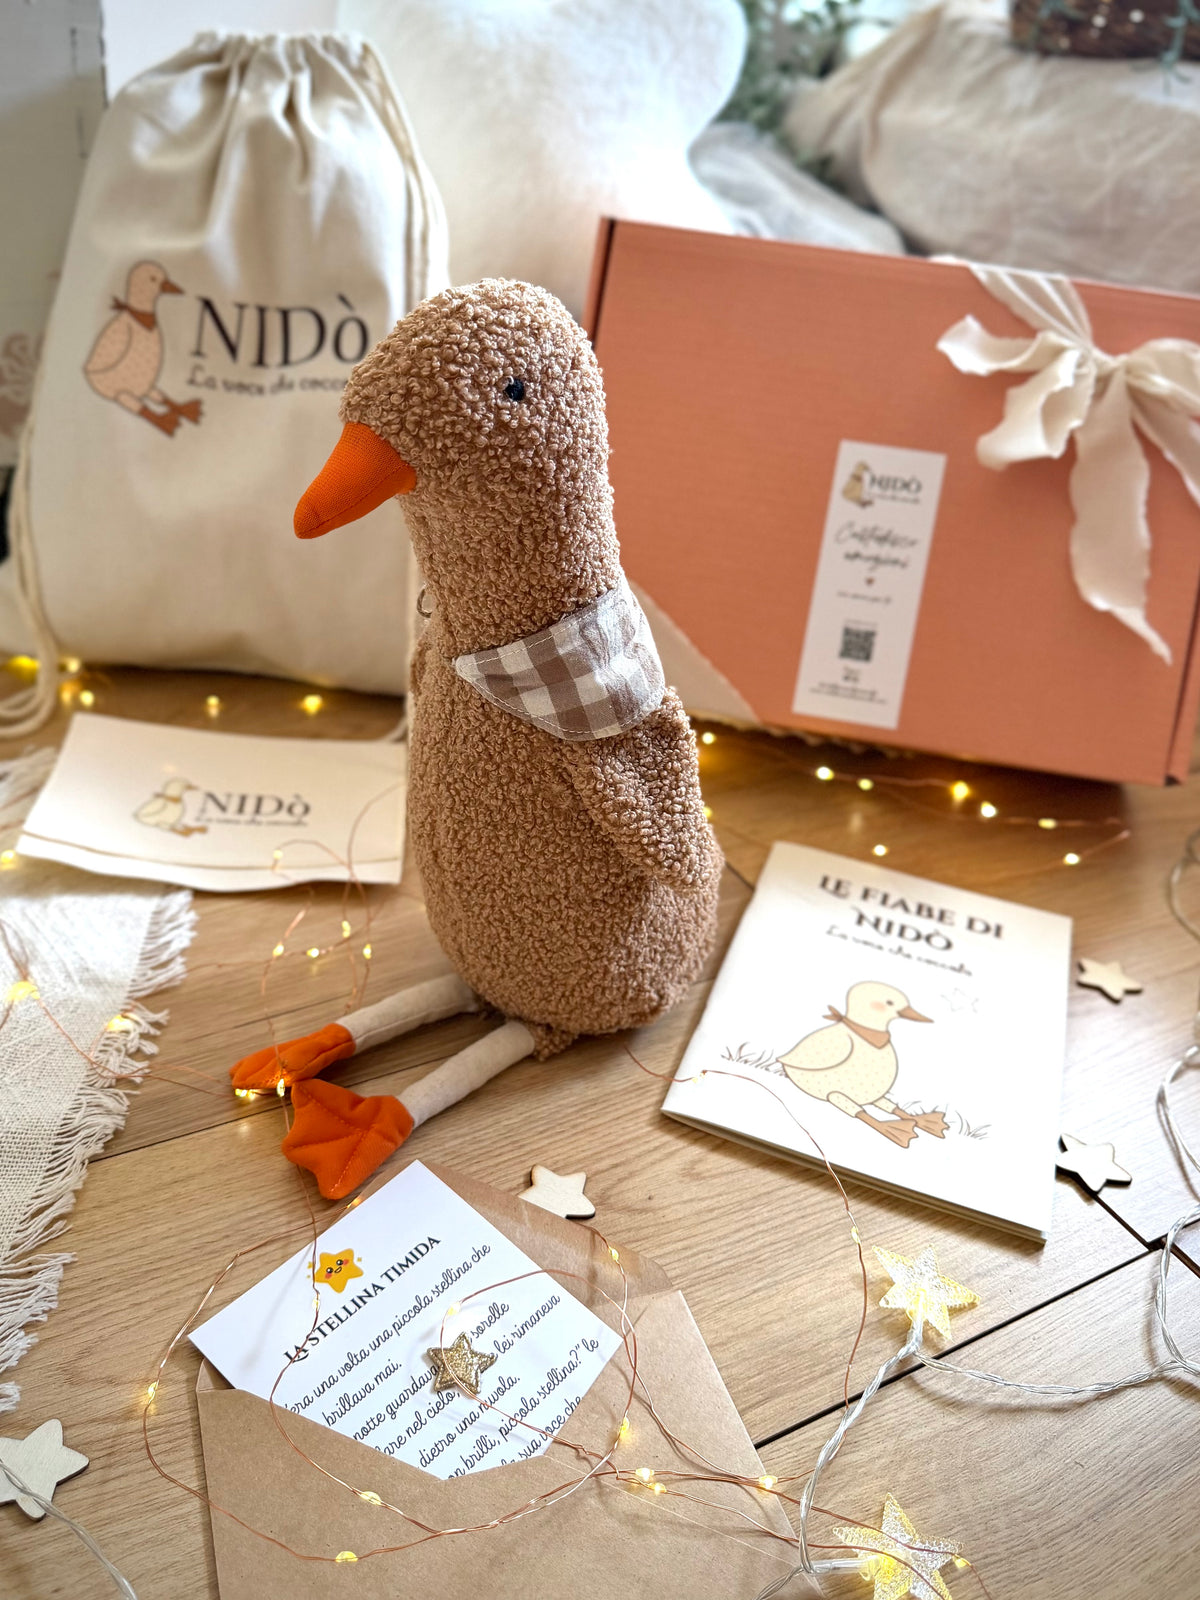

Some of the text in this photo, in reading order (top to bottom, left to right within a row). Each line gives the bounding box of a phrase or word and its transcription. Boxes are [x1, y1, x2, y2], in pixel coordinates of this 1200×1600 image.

[818, 874, 1006, 940] LE FIABE DI
[851, 905, 954, 952] NIDÒ
[284, 1236, 442, 1363] LA STELLINA TIMIDA
[313, 1374, 340, 1399] una
[338, 1351, 371, 1379] volta
[368, 1329, 394, 1352] una
[391, 1294, 434, 1337] piccola
[431, 1260, 473, 1298] stellina
[471, 1244, 491, 1263] che
[322, 1358, 403, 1428] brillava mai.
[353, 1301, 510, 1442] notte guardava sorelle
[405, 1410, 428, 1438] nel
[426, 1390, 461, 1419] cielo,
[493, 1334, 515, 1355] lei
[511, 1294, 562, 1340] rimaneva
[459, 1434, 501, 1470] brilli,
[498, 1396, 540, 1442] piccola
[581, 1338, 599, 1353] le
[419, 1375, 521, 1468] dietro una nuvola.
[518, 1438, 542, 1460] sua
[539, 1414, 566, 1442] voce
